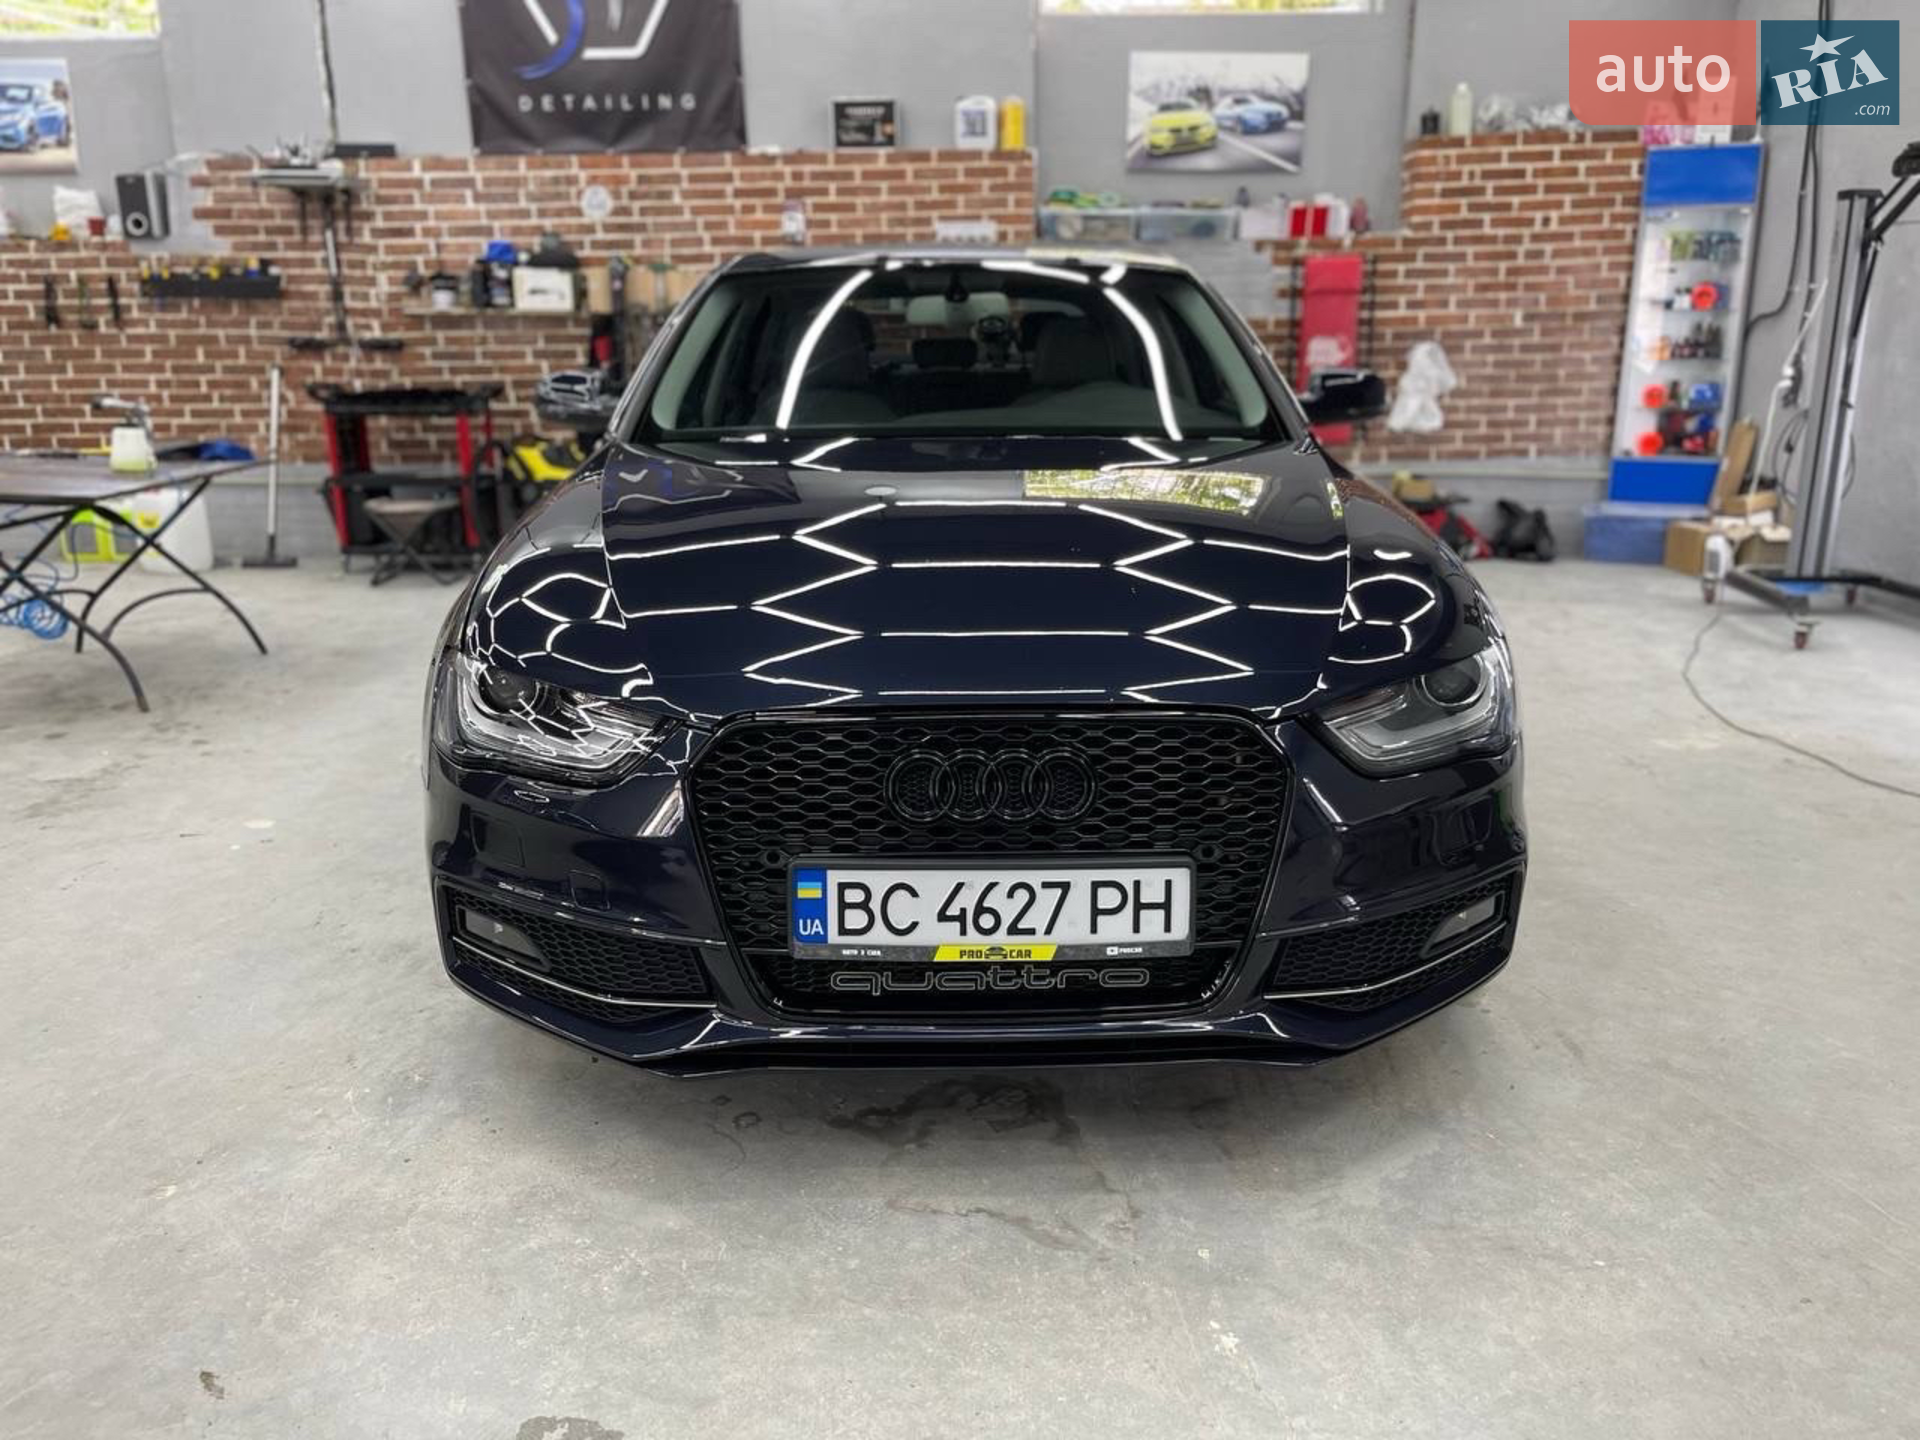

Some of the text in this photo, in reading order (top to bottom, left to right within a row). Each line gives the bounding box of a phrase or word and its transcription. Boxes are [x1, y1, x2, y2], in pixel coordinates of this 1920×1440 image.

[518, 93, 697, 113] DETAILING
[837, 879, 1172, 936] BC 4627 PH
[799, 919, 824, 936] UA
[960, 949, 1032, 959] PRO CAR
[830, 965, 1150, 996] quattro
